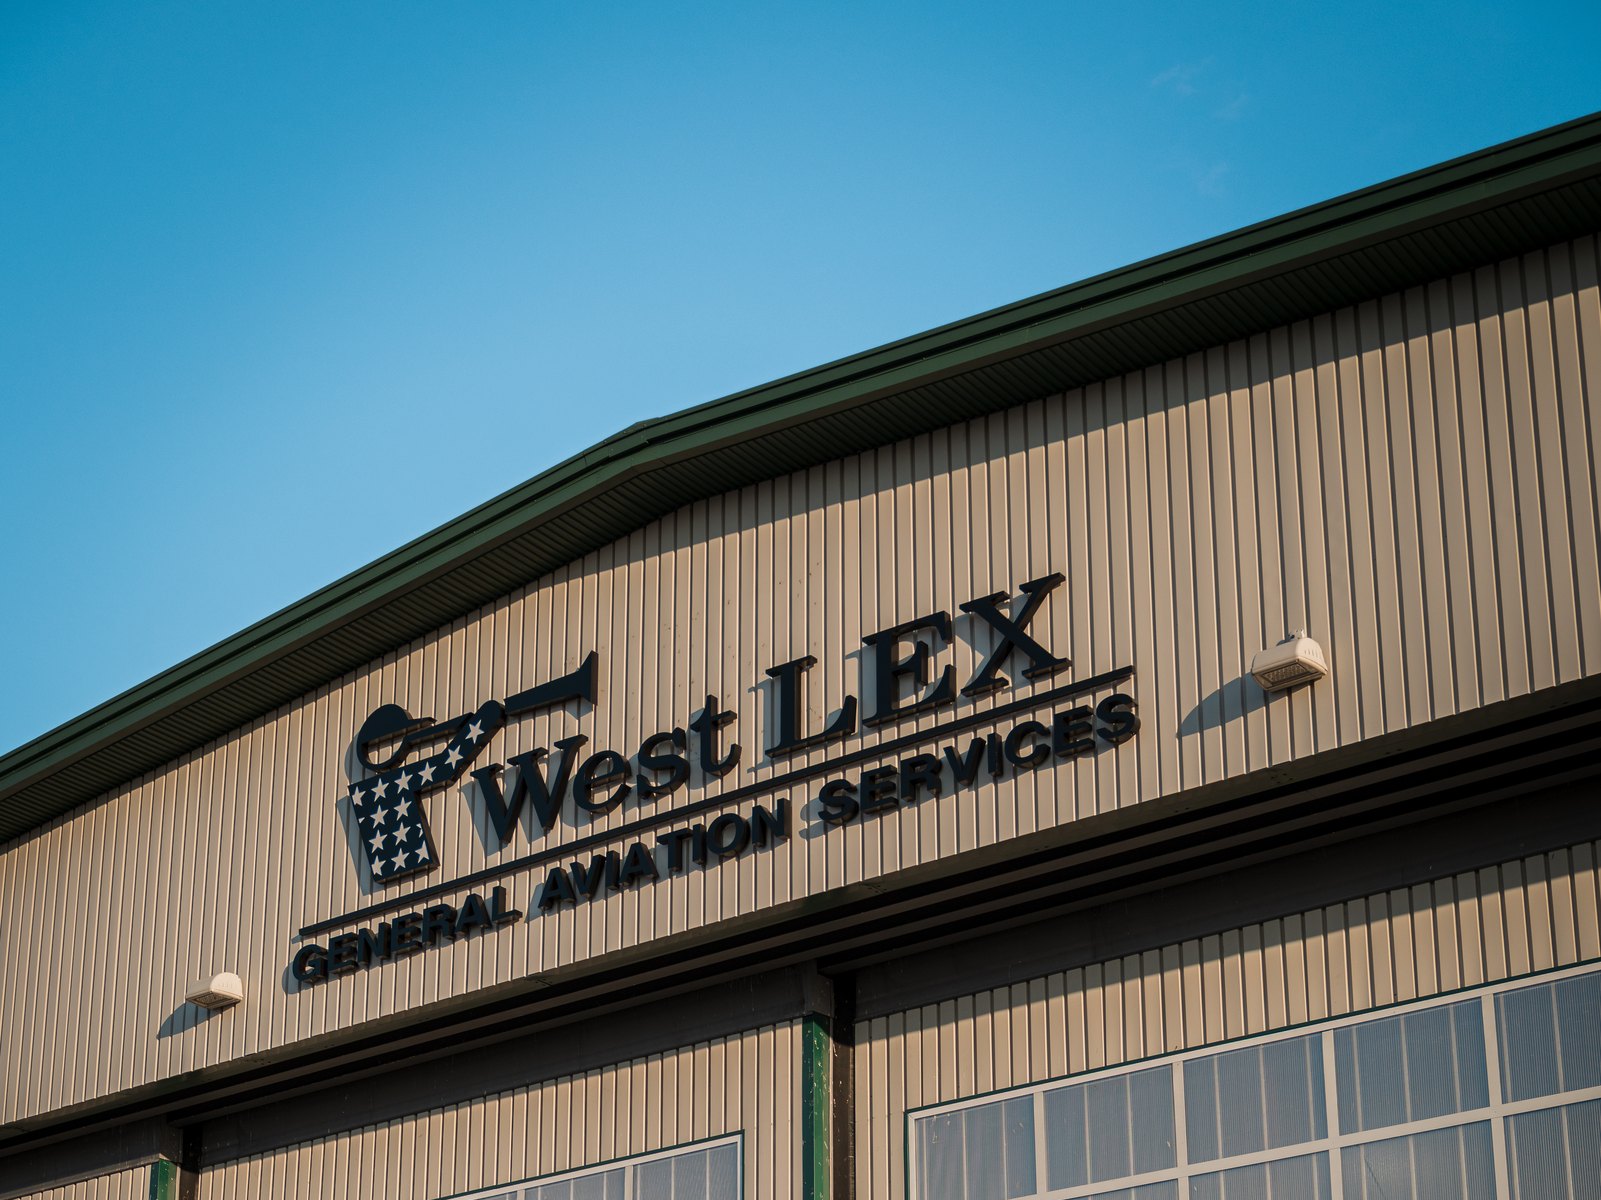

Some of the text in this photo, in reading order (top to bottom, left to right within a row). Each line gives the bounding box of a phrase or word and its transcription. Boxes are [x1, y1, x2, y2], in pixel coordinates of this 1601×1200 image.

[292, 693, 1141, 984] GENERAL AVIATION SERVICES
[470, 572, 1071, 844] West LEX
